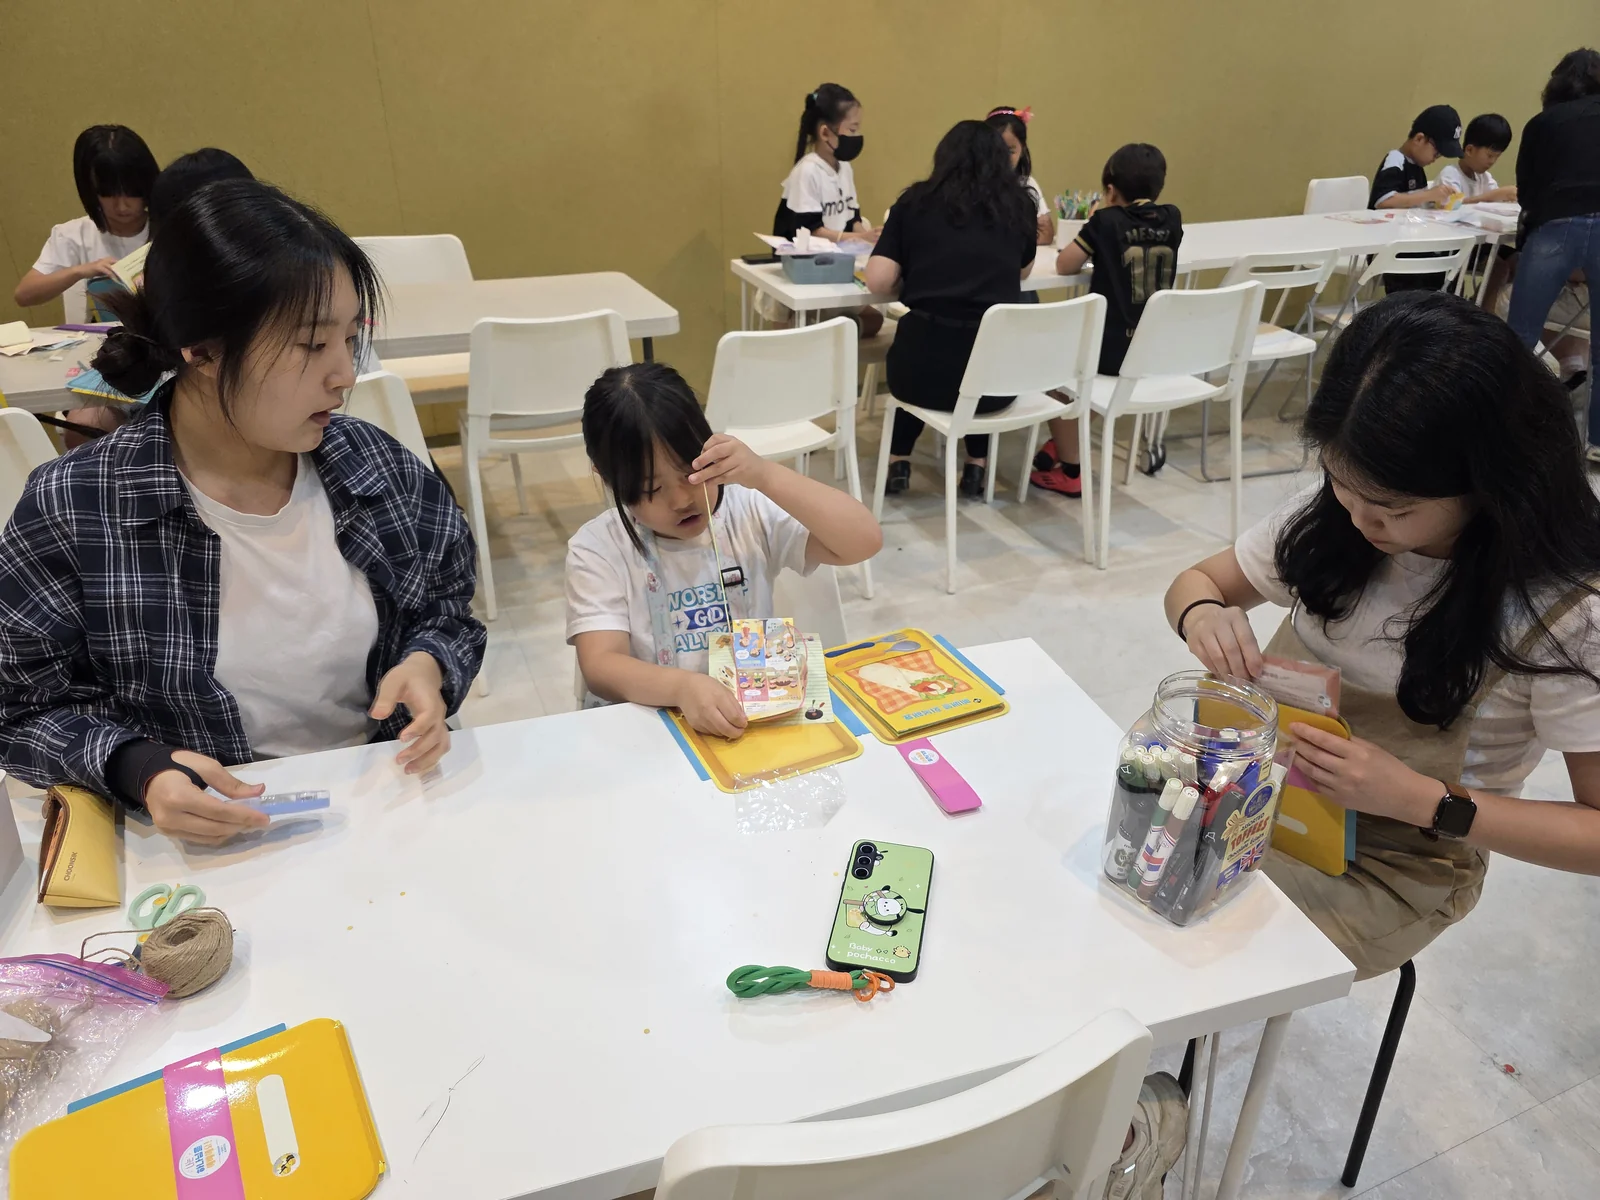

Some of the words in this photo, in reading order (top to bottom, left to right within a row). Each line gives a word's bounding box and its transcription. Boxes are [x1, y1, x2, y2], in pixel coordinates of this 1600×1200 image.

[1125, 227, 1171, 243] MESSI
[1121, 245, 1174, 304] 10
[1231, 816, 1270, 851] TOFFEES
[63, 851, 78, 881] CHOONSIK
[847, 951, 896, 964] pochacco
[849, 942, 873, 952] Baby
